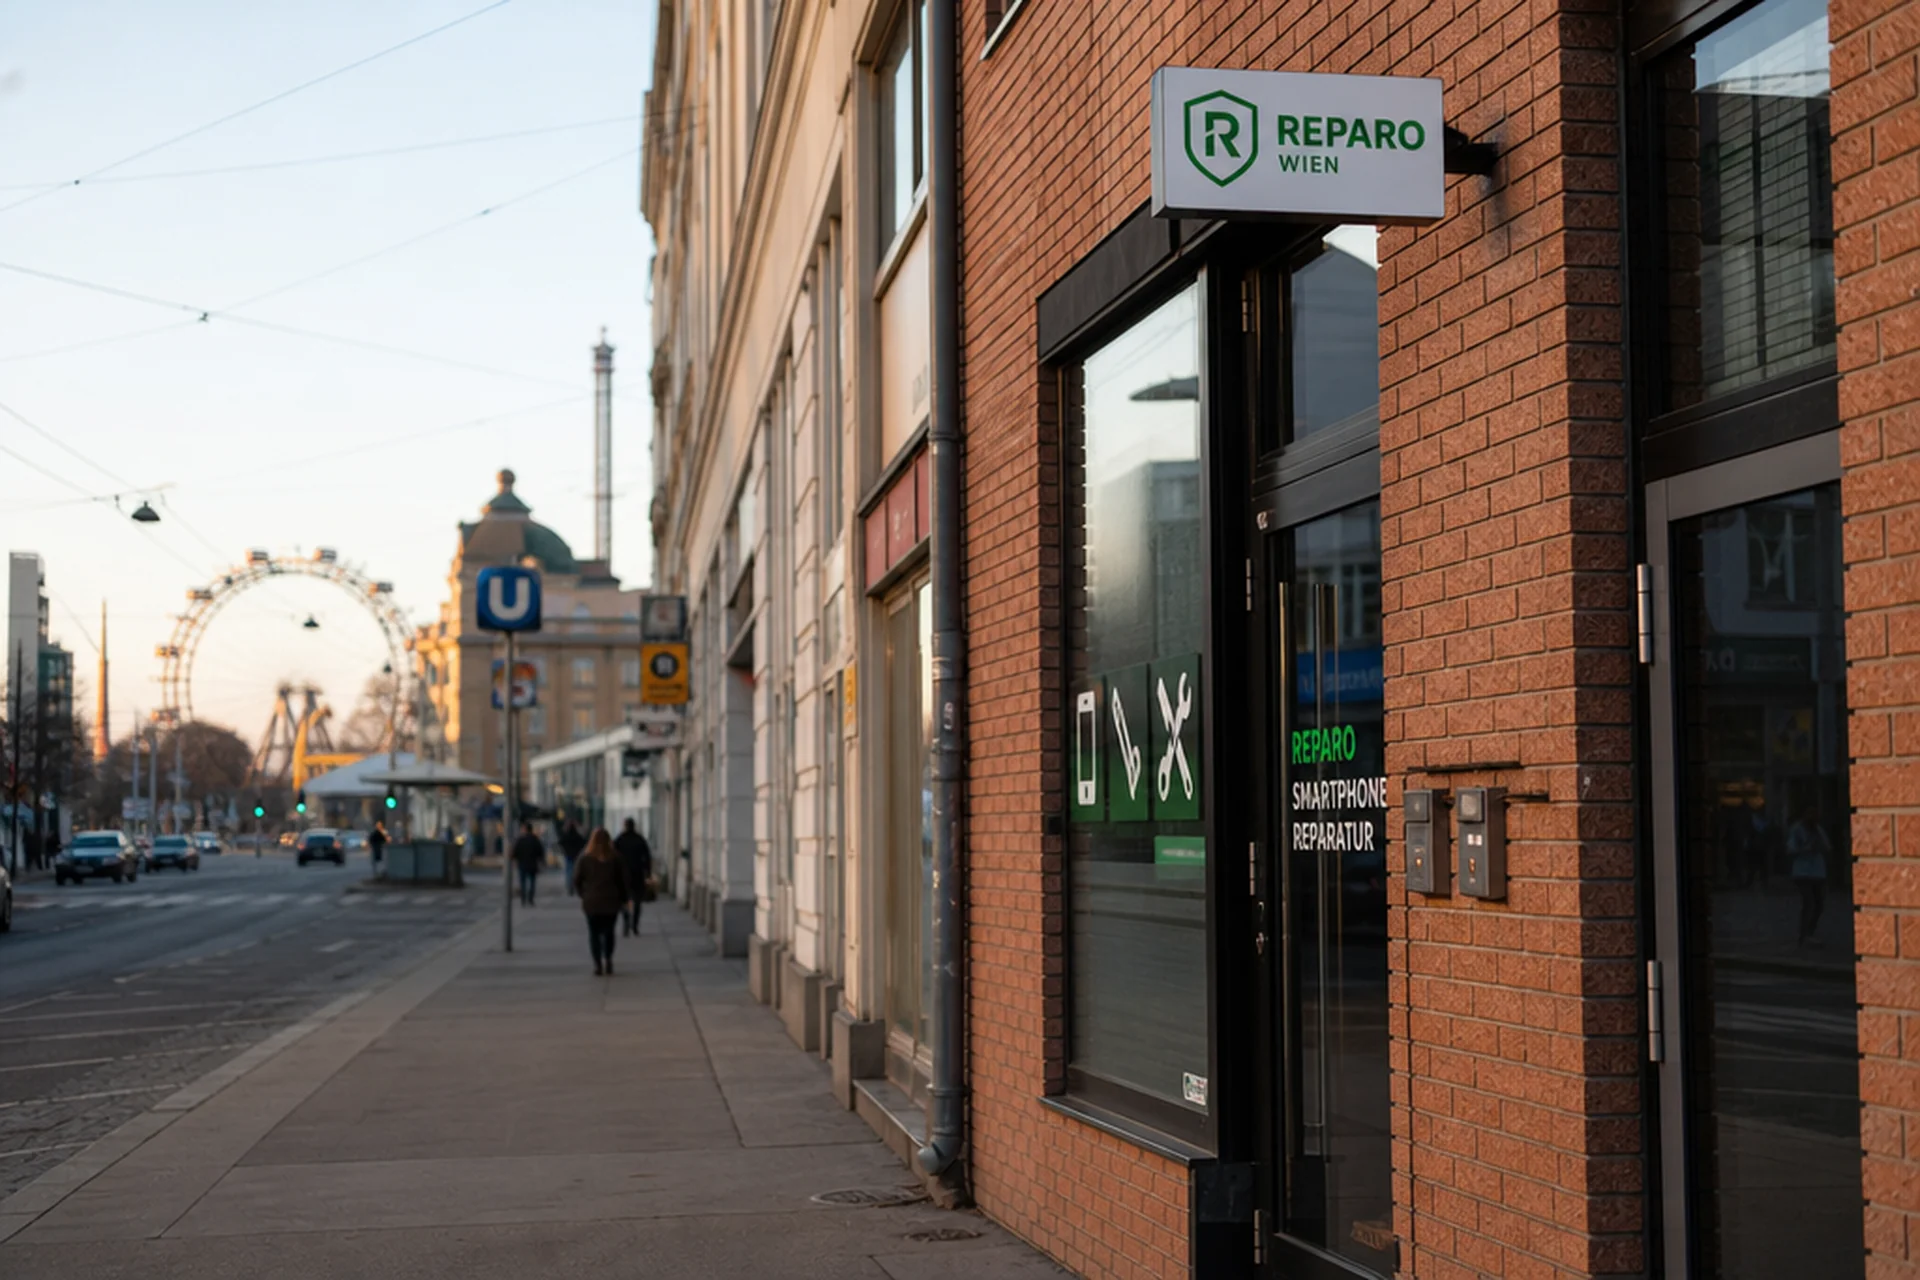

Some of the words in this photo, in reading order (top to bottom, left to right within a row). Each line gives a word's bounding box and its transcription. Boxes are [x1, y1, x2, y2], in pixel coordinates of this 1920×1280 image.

[1205, 111, 1240, 157] R
[1277, 114, 1425, 151] REPARO
[1278, 154, 1339, 174] WIEN
[489, 577, 530, 620] U
[1292, 725, 1356, 764] REPARO
[1292, 777, 1388, 810] SMARTPHONE
[1293, 821, 1374, 851] REPARATUR
